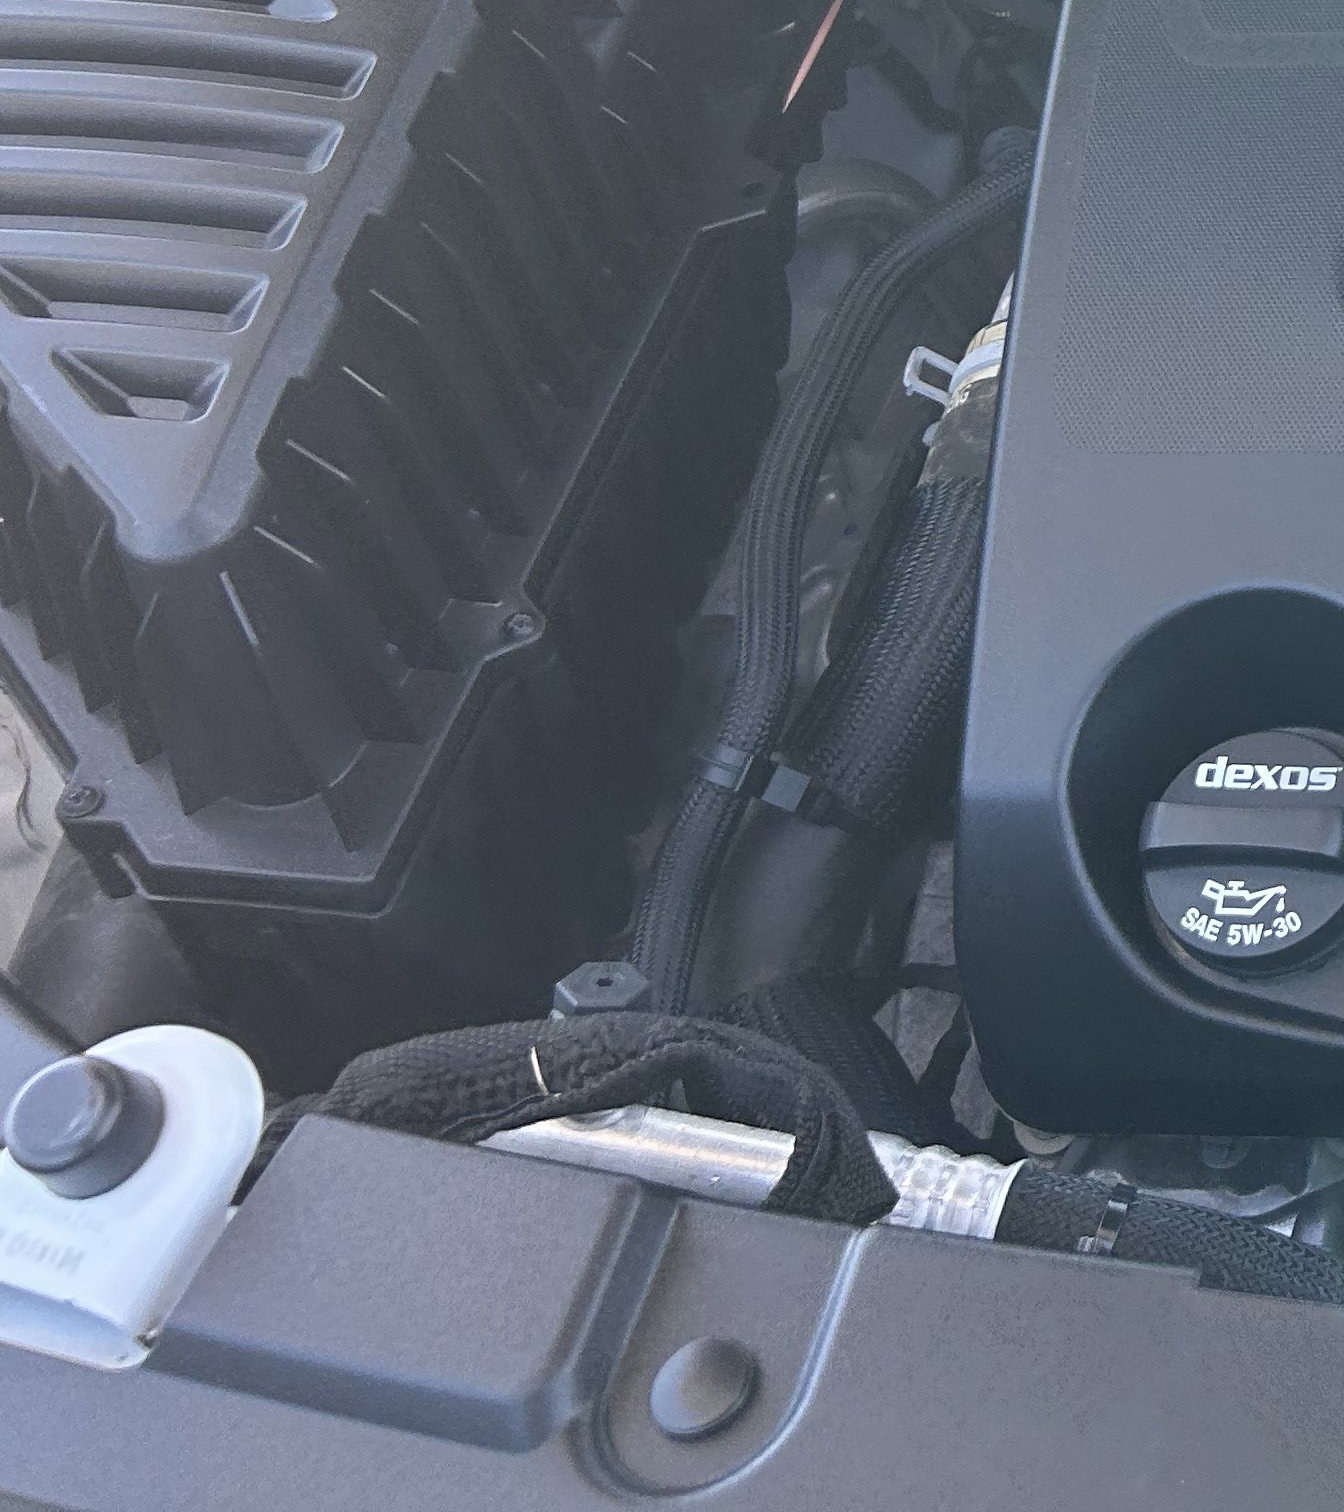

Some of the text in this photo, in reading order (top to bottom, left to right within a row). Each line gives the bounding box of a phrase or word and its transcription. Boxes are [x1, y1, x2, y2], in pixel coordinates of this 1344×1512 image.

[1195, 755, 1340, 791] dexos
[1181, 907, 1302, 945] SAE 5W-30
